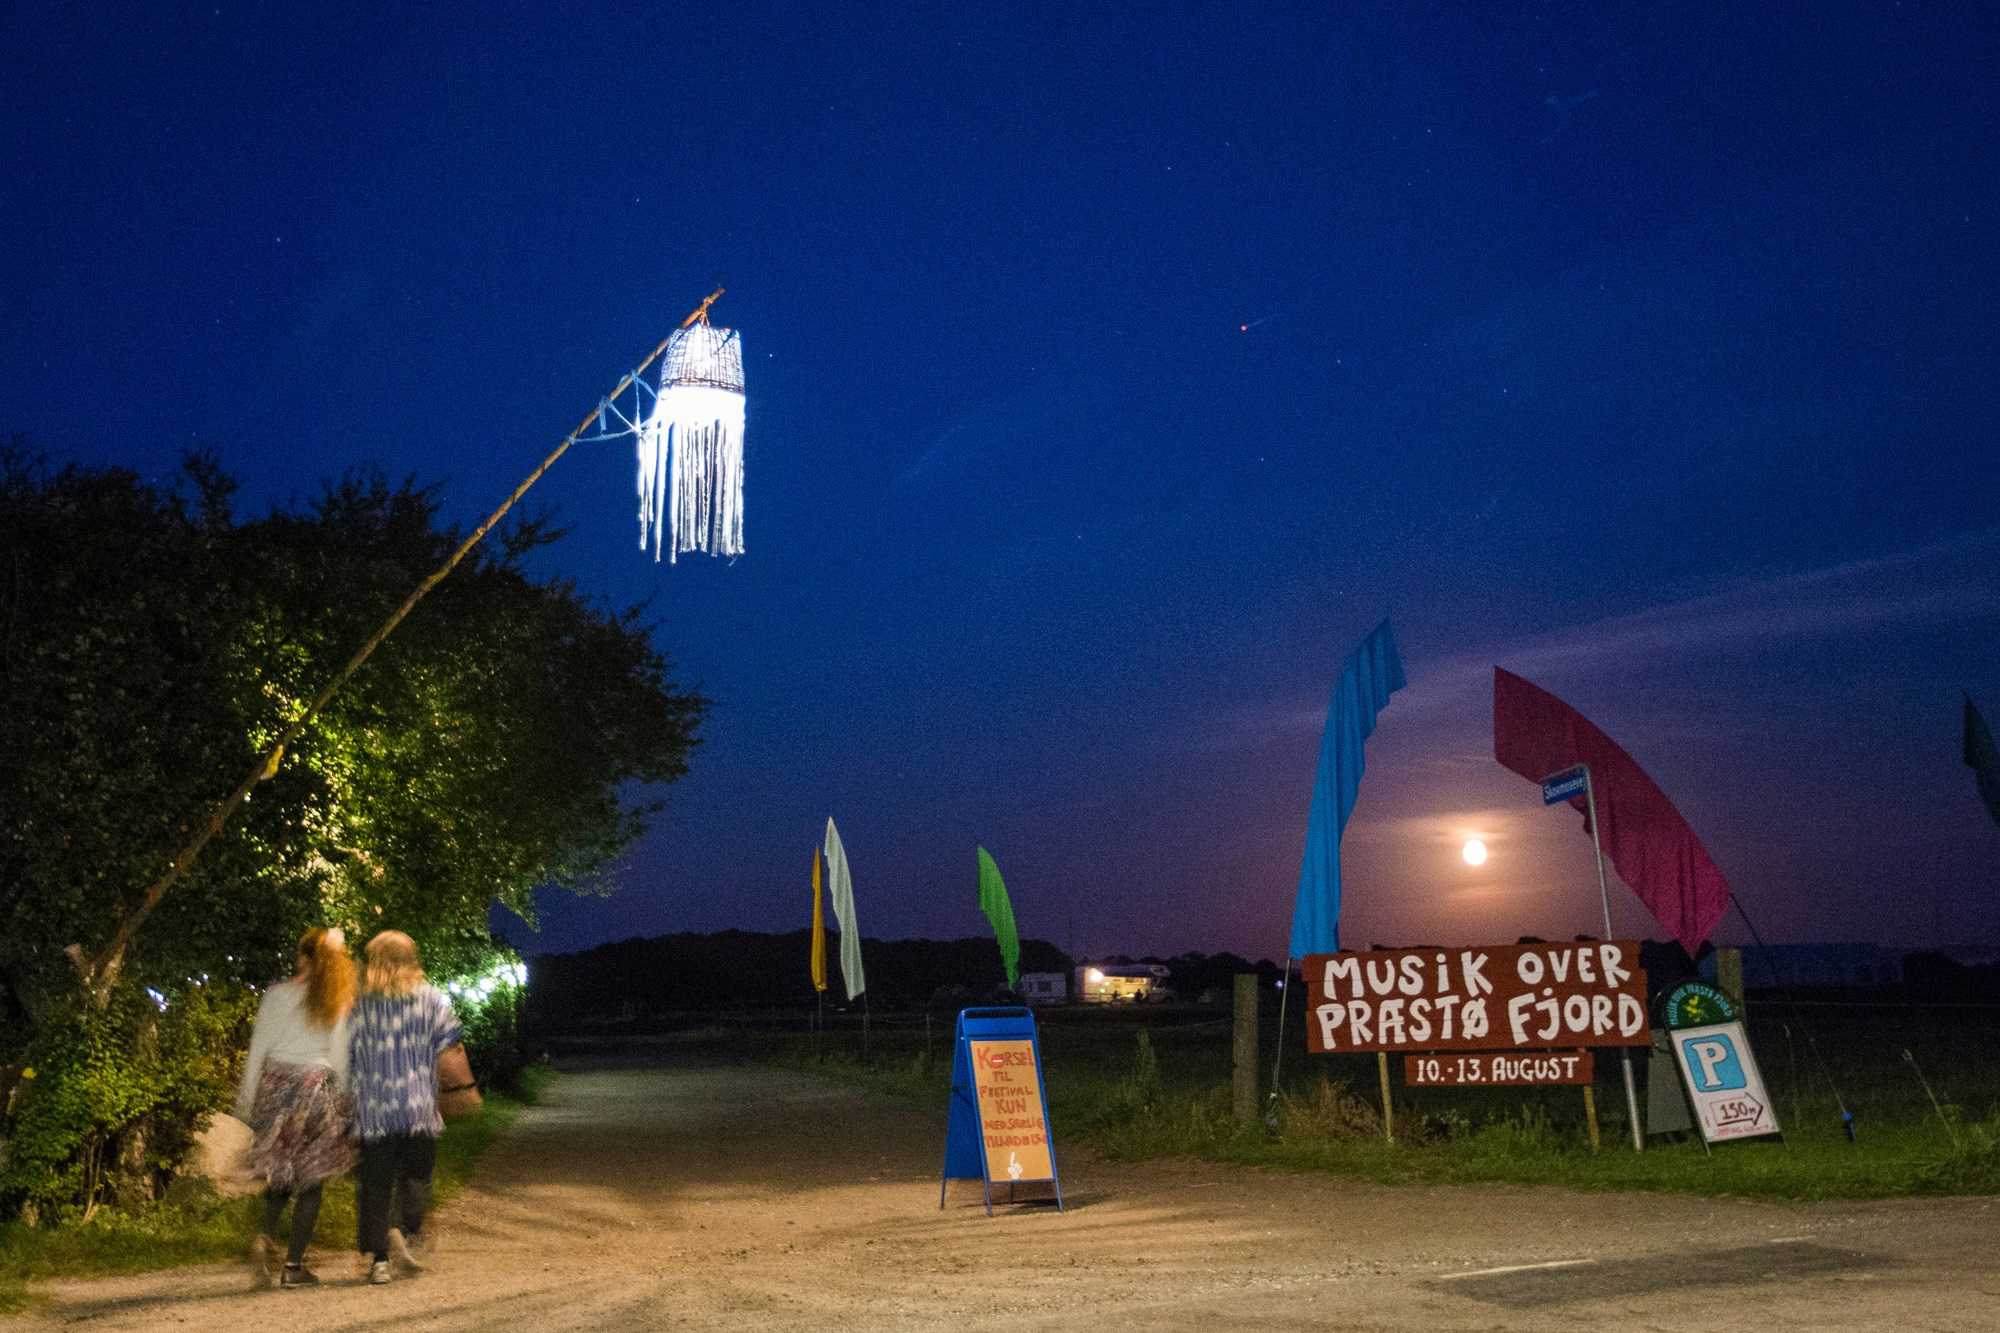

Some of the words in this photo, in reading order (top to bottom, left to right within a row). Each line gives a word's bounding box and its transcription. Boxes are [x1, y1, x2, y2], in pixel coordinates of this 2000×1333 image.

[1517, 944, 1631, 988] OVER
[1316, 995, 1489, 1049] PRÆSTØ
[991, 1071, 1014, 1082] TIL
[1492, 1057, 1579, 1081] AUGUST
[1691, 1041, 1727, 1087] P
[995, 1098, 1026, 1114] KUN
